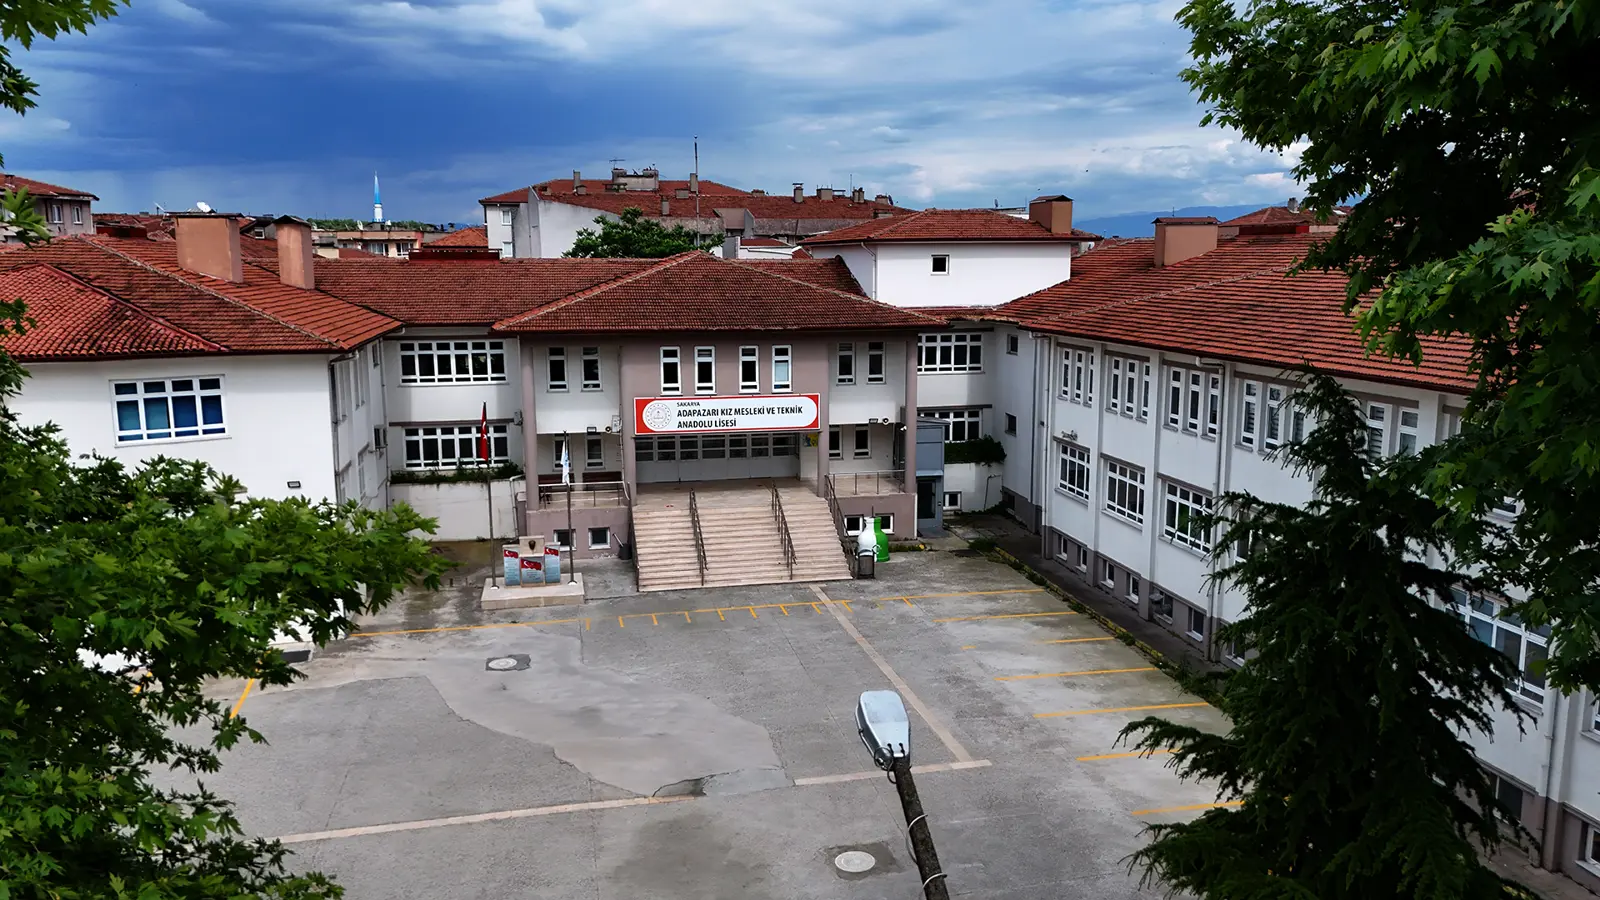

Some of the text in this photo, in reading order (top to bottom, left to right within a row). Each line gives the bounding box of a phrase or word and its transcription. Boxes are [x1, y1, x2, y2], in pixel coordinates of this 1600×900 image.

[677, 405, 803, 417] ADAPAZARI KIZ MESLEKİ VE TEKNİK
[677, 418, 737, 428] ANADOLU LİSESİ
